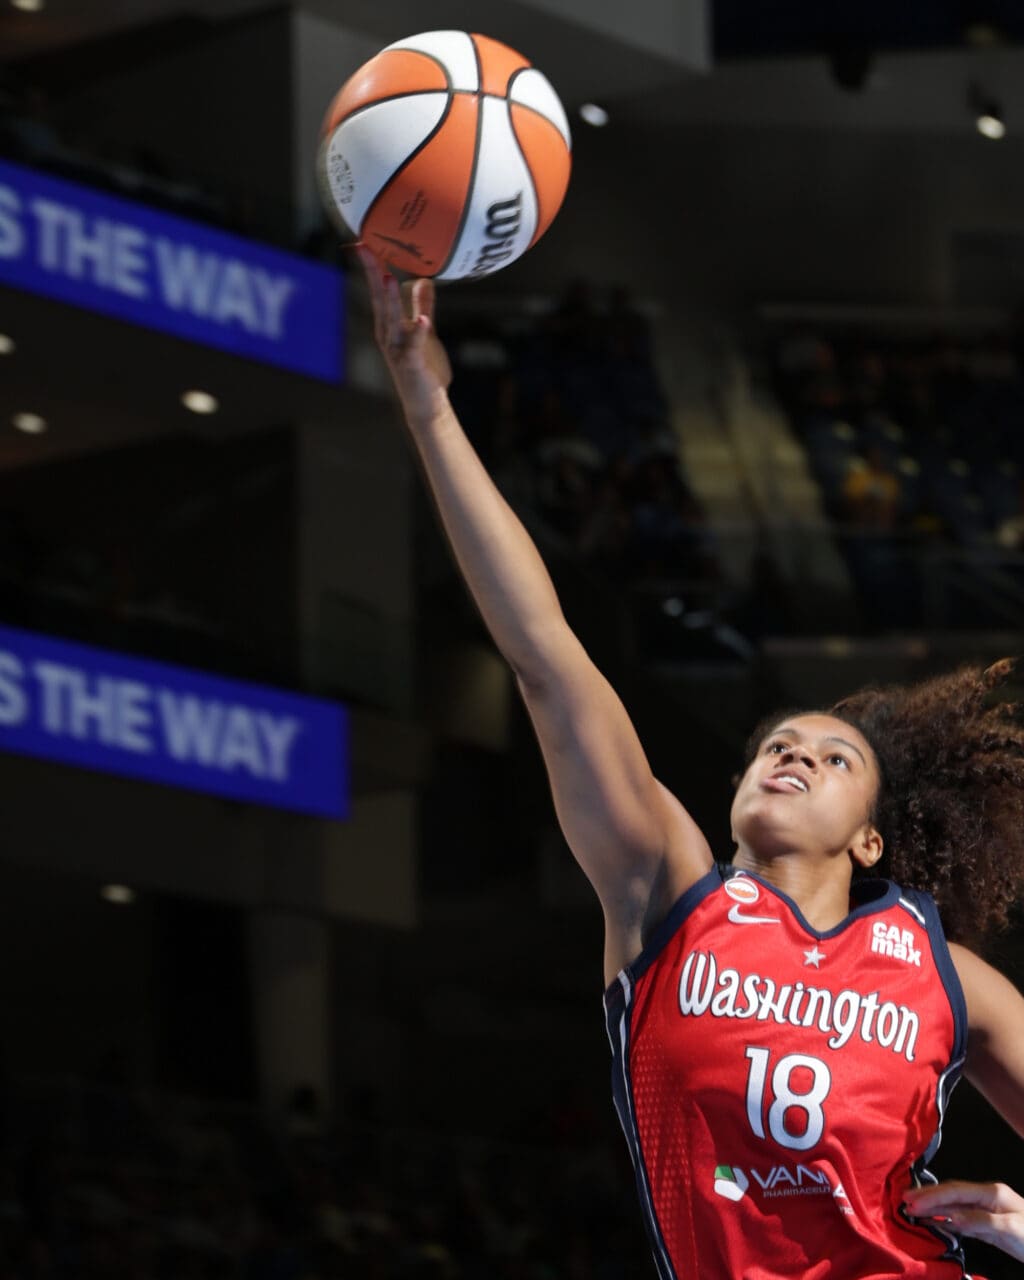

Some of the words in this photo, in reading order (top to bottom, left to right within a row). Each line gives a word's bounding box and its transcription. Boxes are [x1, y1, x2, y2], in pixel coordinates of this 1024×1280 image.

[31, 197, 148, 300] THE
[153, 235, 295, 342] WAY
[470, 190, 523, 277] Wils
[34, 660, 154, 754] THE
[159, 684, 299, 782] WAY
[871, 935, 921, 967] max
[872, 921, 915, 948] CAR
[745, 1046, 832, 1150] 18
